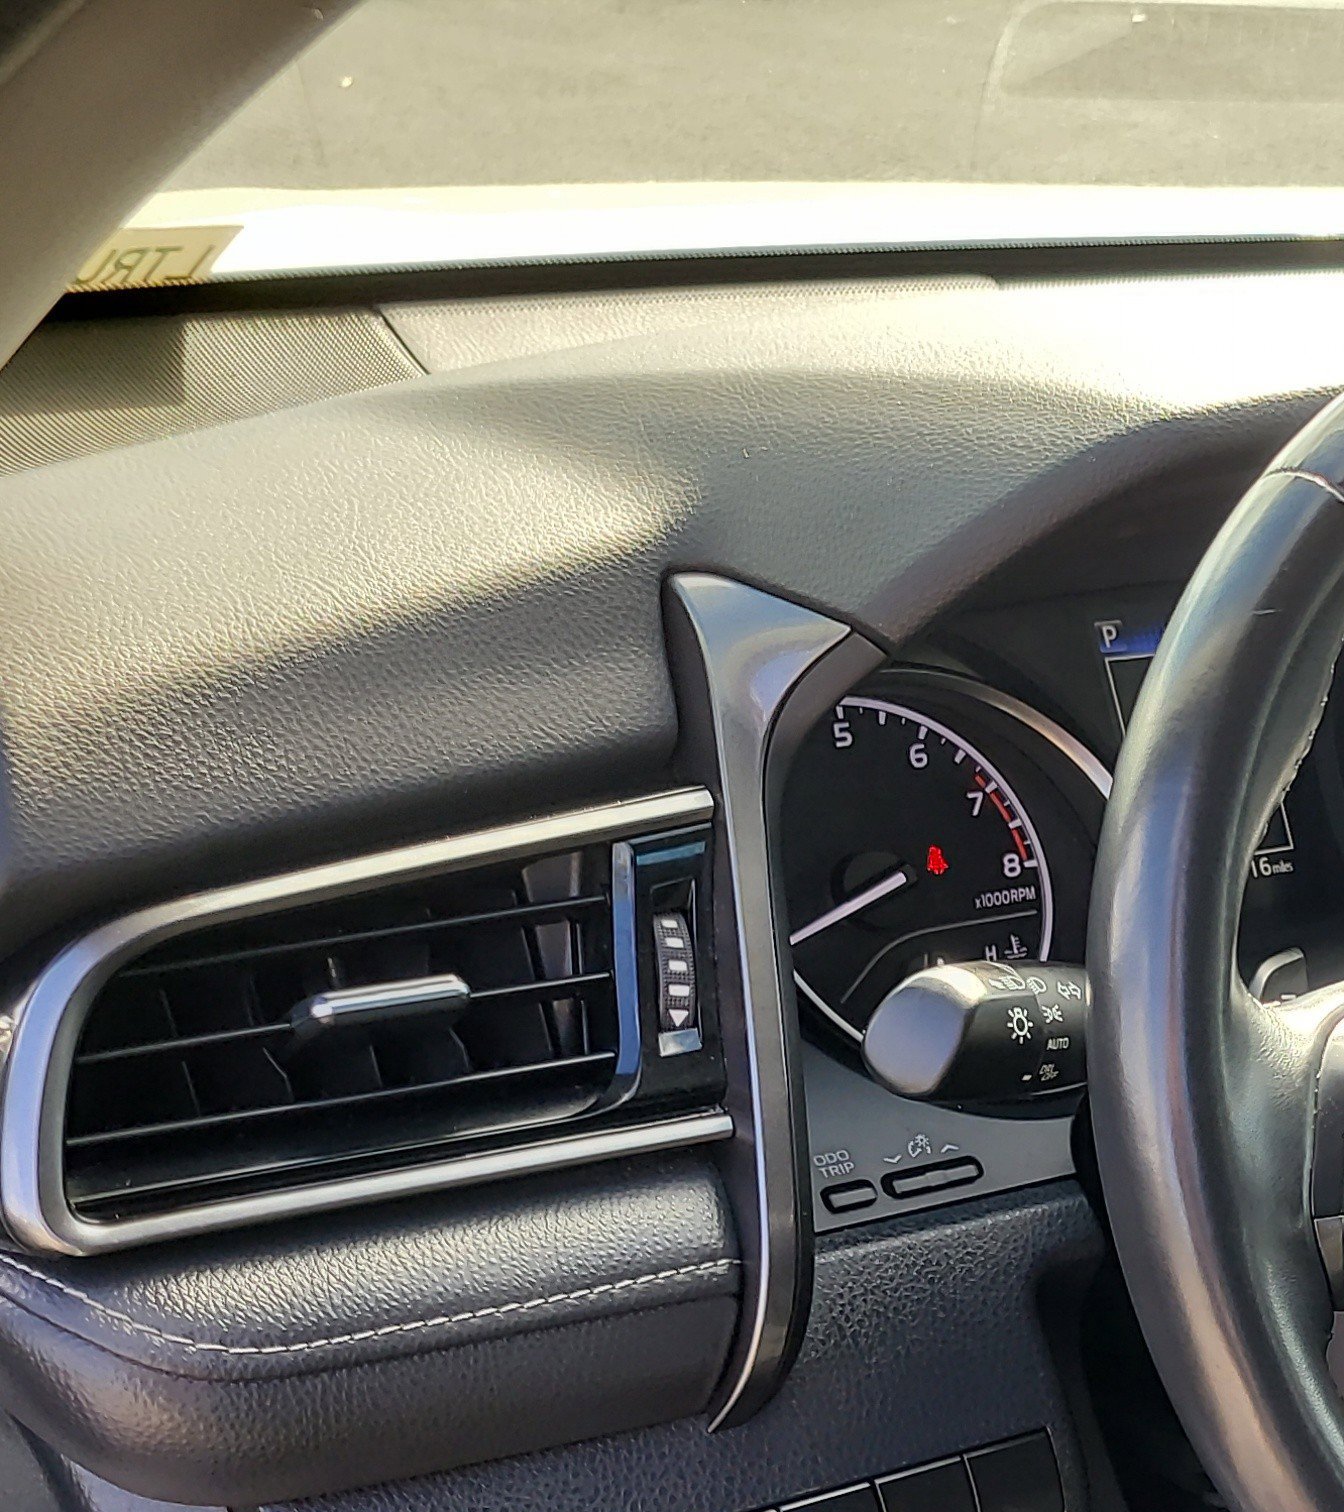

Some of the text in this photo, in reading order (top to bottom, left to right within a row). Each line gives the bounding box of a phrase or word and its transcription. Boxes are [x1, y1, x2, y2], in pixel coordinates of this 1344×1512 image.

[1102, 625, 1117, 648] P
[832, 721, 854, 748] 5
[909, 743, 929, 769] 6
[966, 790, 984, 817] 7
[1002, 853, 1022, 878] 8
[1272, 860, 1294, 874] miles
[985, 944, 997, 961] H
[1047, 1036, 1070, 1050] AUTO
[813, 1149, 850, 1168] ODO
[819, 1161, 856, 1178] TRIP
